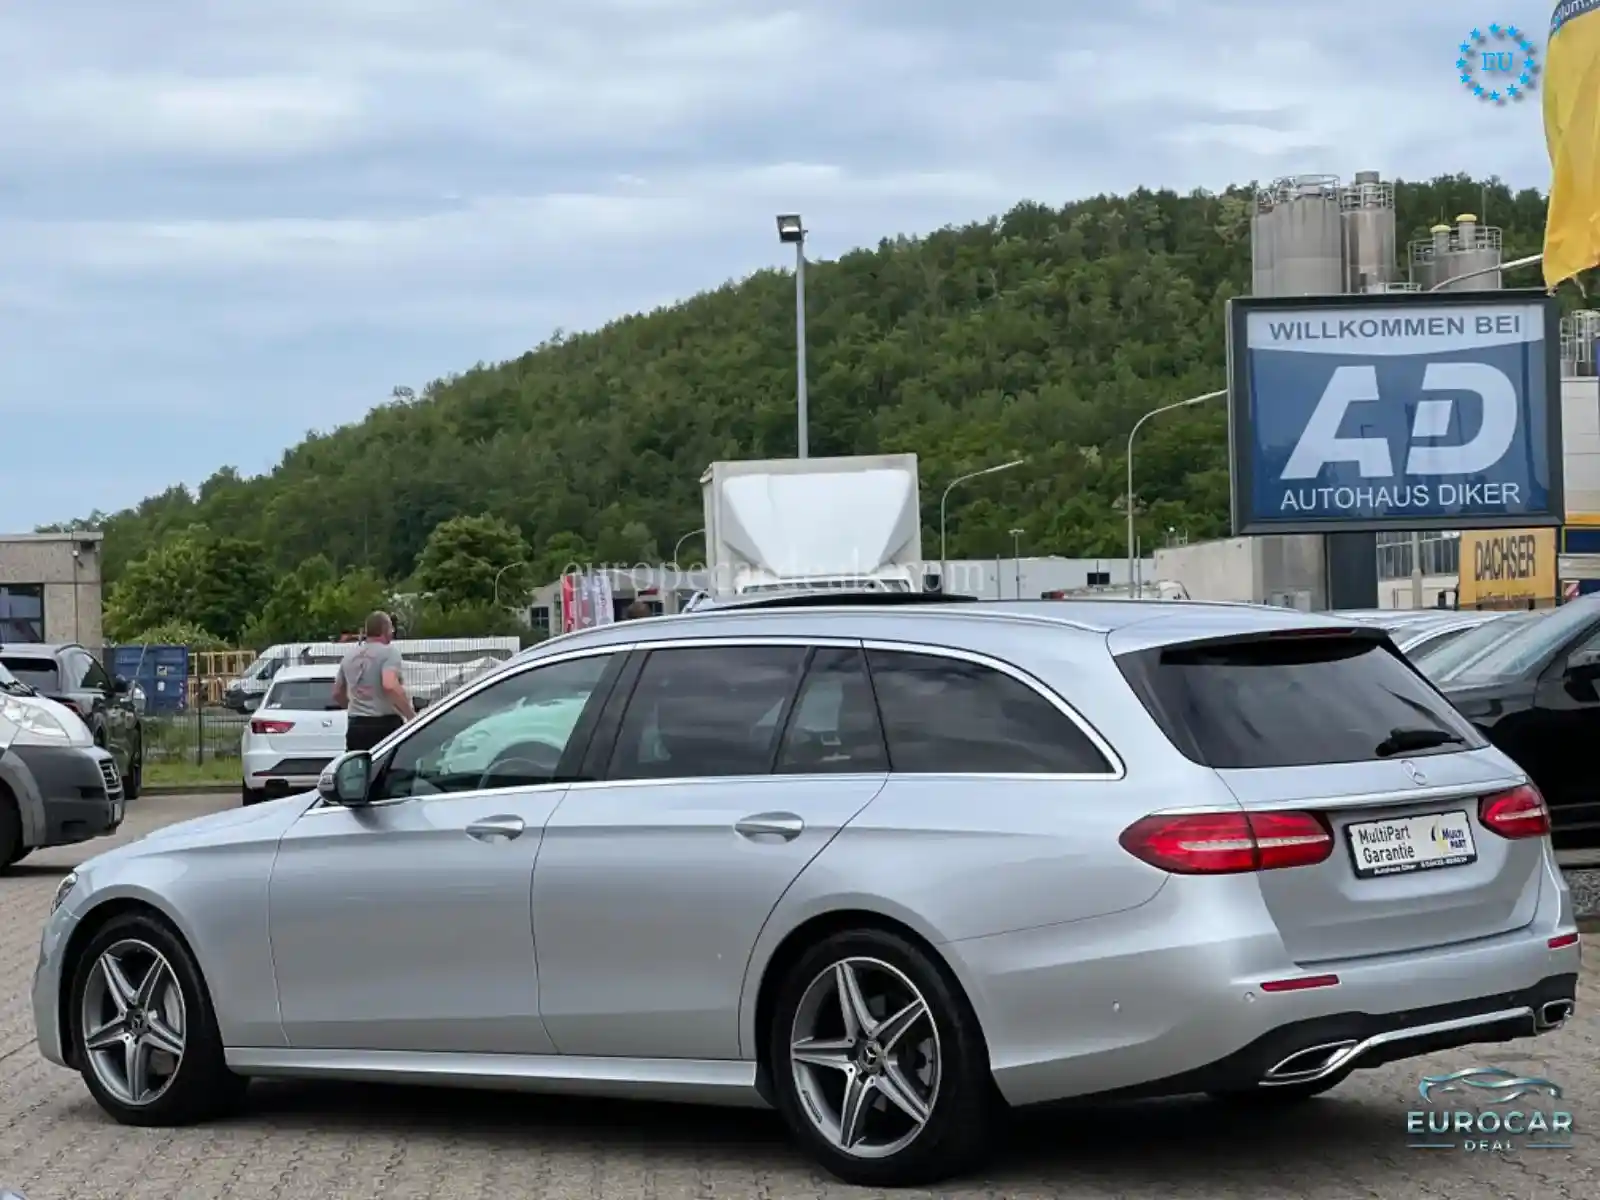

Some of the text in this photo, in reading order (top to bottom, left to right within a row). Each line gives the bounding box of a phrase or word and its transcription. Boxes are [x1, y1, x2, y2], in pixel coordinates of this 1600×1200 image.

[1269, 315, 1521, 340] WILLKOMMEN BEI
[1280, 361, 1518, 480] AD
[1280, 483, 1521, 510] AUTOHAUS DIKER
[1475, 534, 1536, 581] DACHSER
[1358, 825, 1411, 845] MultiPart
[1363, 843, 1415, 864] Garantie
